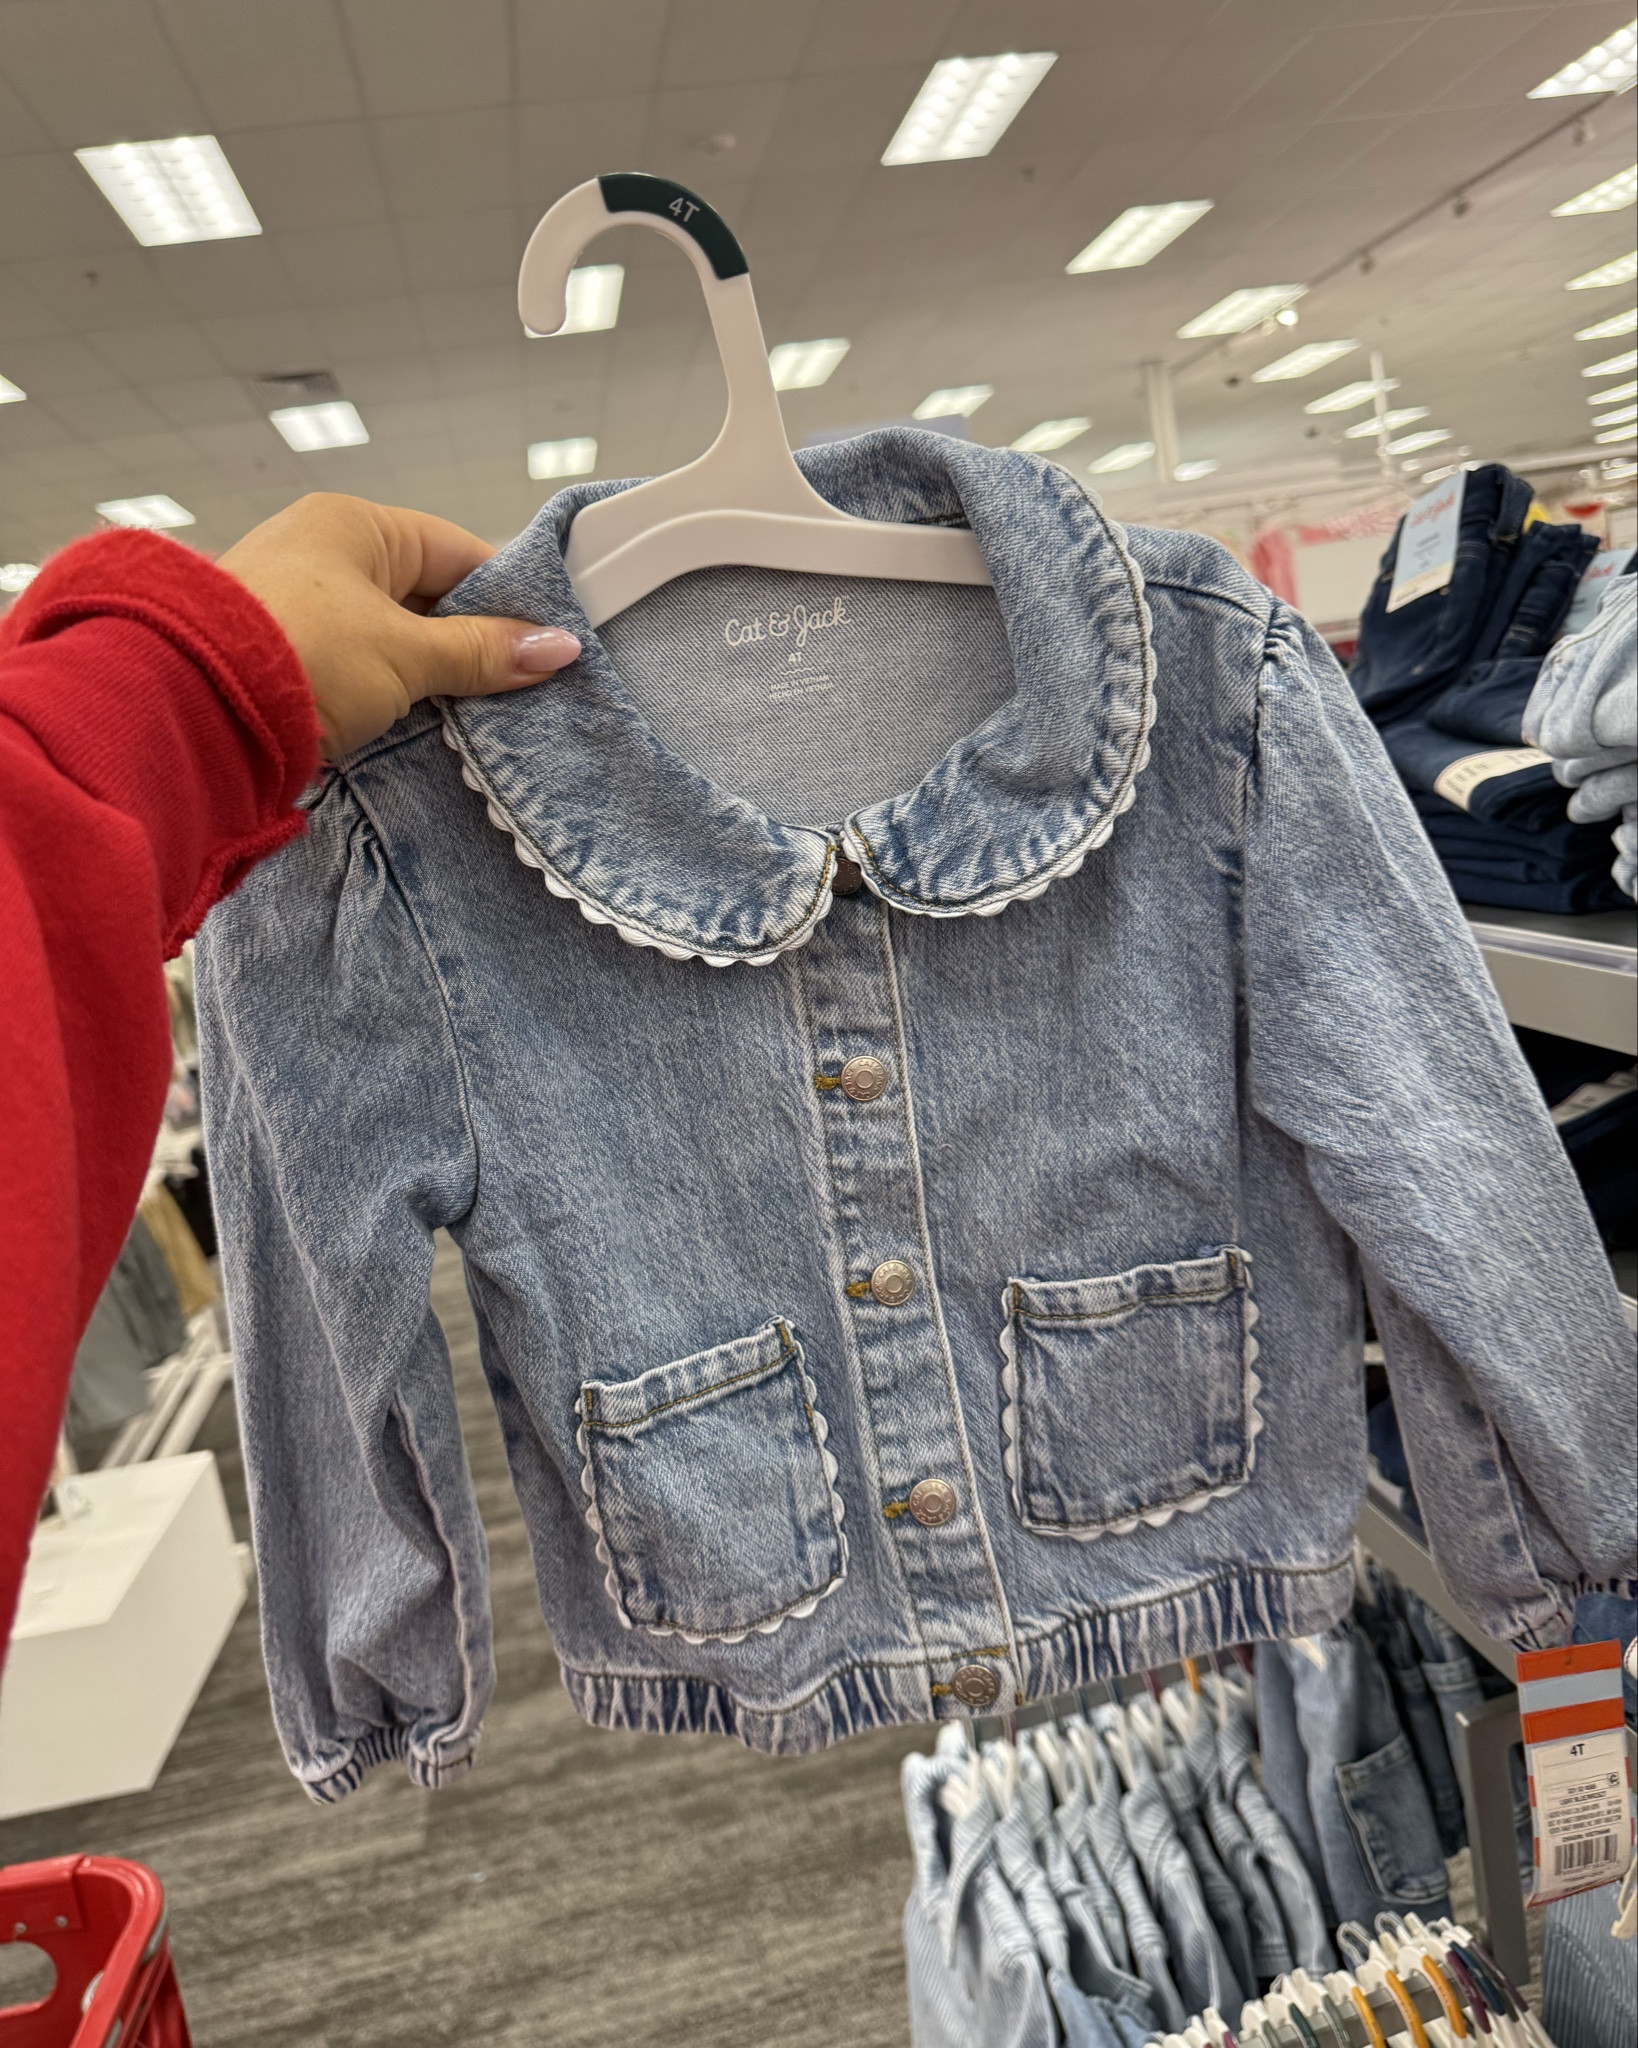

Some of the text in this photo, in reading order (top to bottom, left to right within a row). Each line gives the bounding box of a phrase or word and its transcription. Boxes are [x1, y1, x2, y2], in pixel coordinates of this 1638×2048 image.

[668, 197, 701, 222] 4T
[725, 596, 852, 648] Cat & Jack
[788, 652, 802, 665] 4T
[1570, 1743, 1586, 1756] 4T
